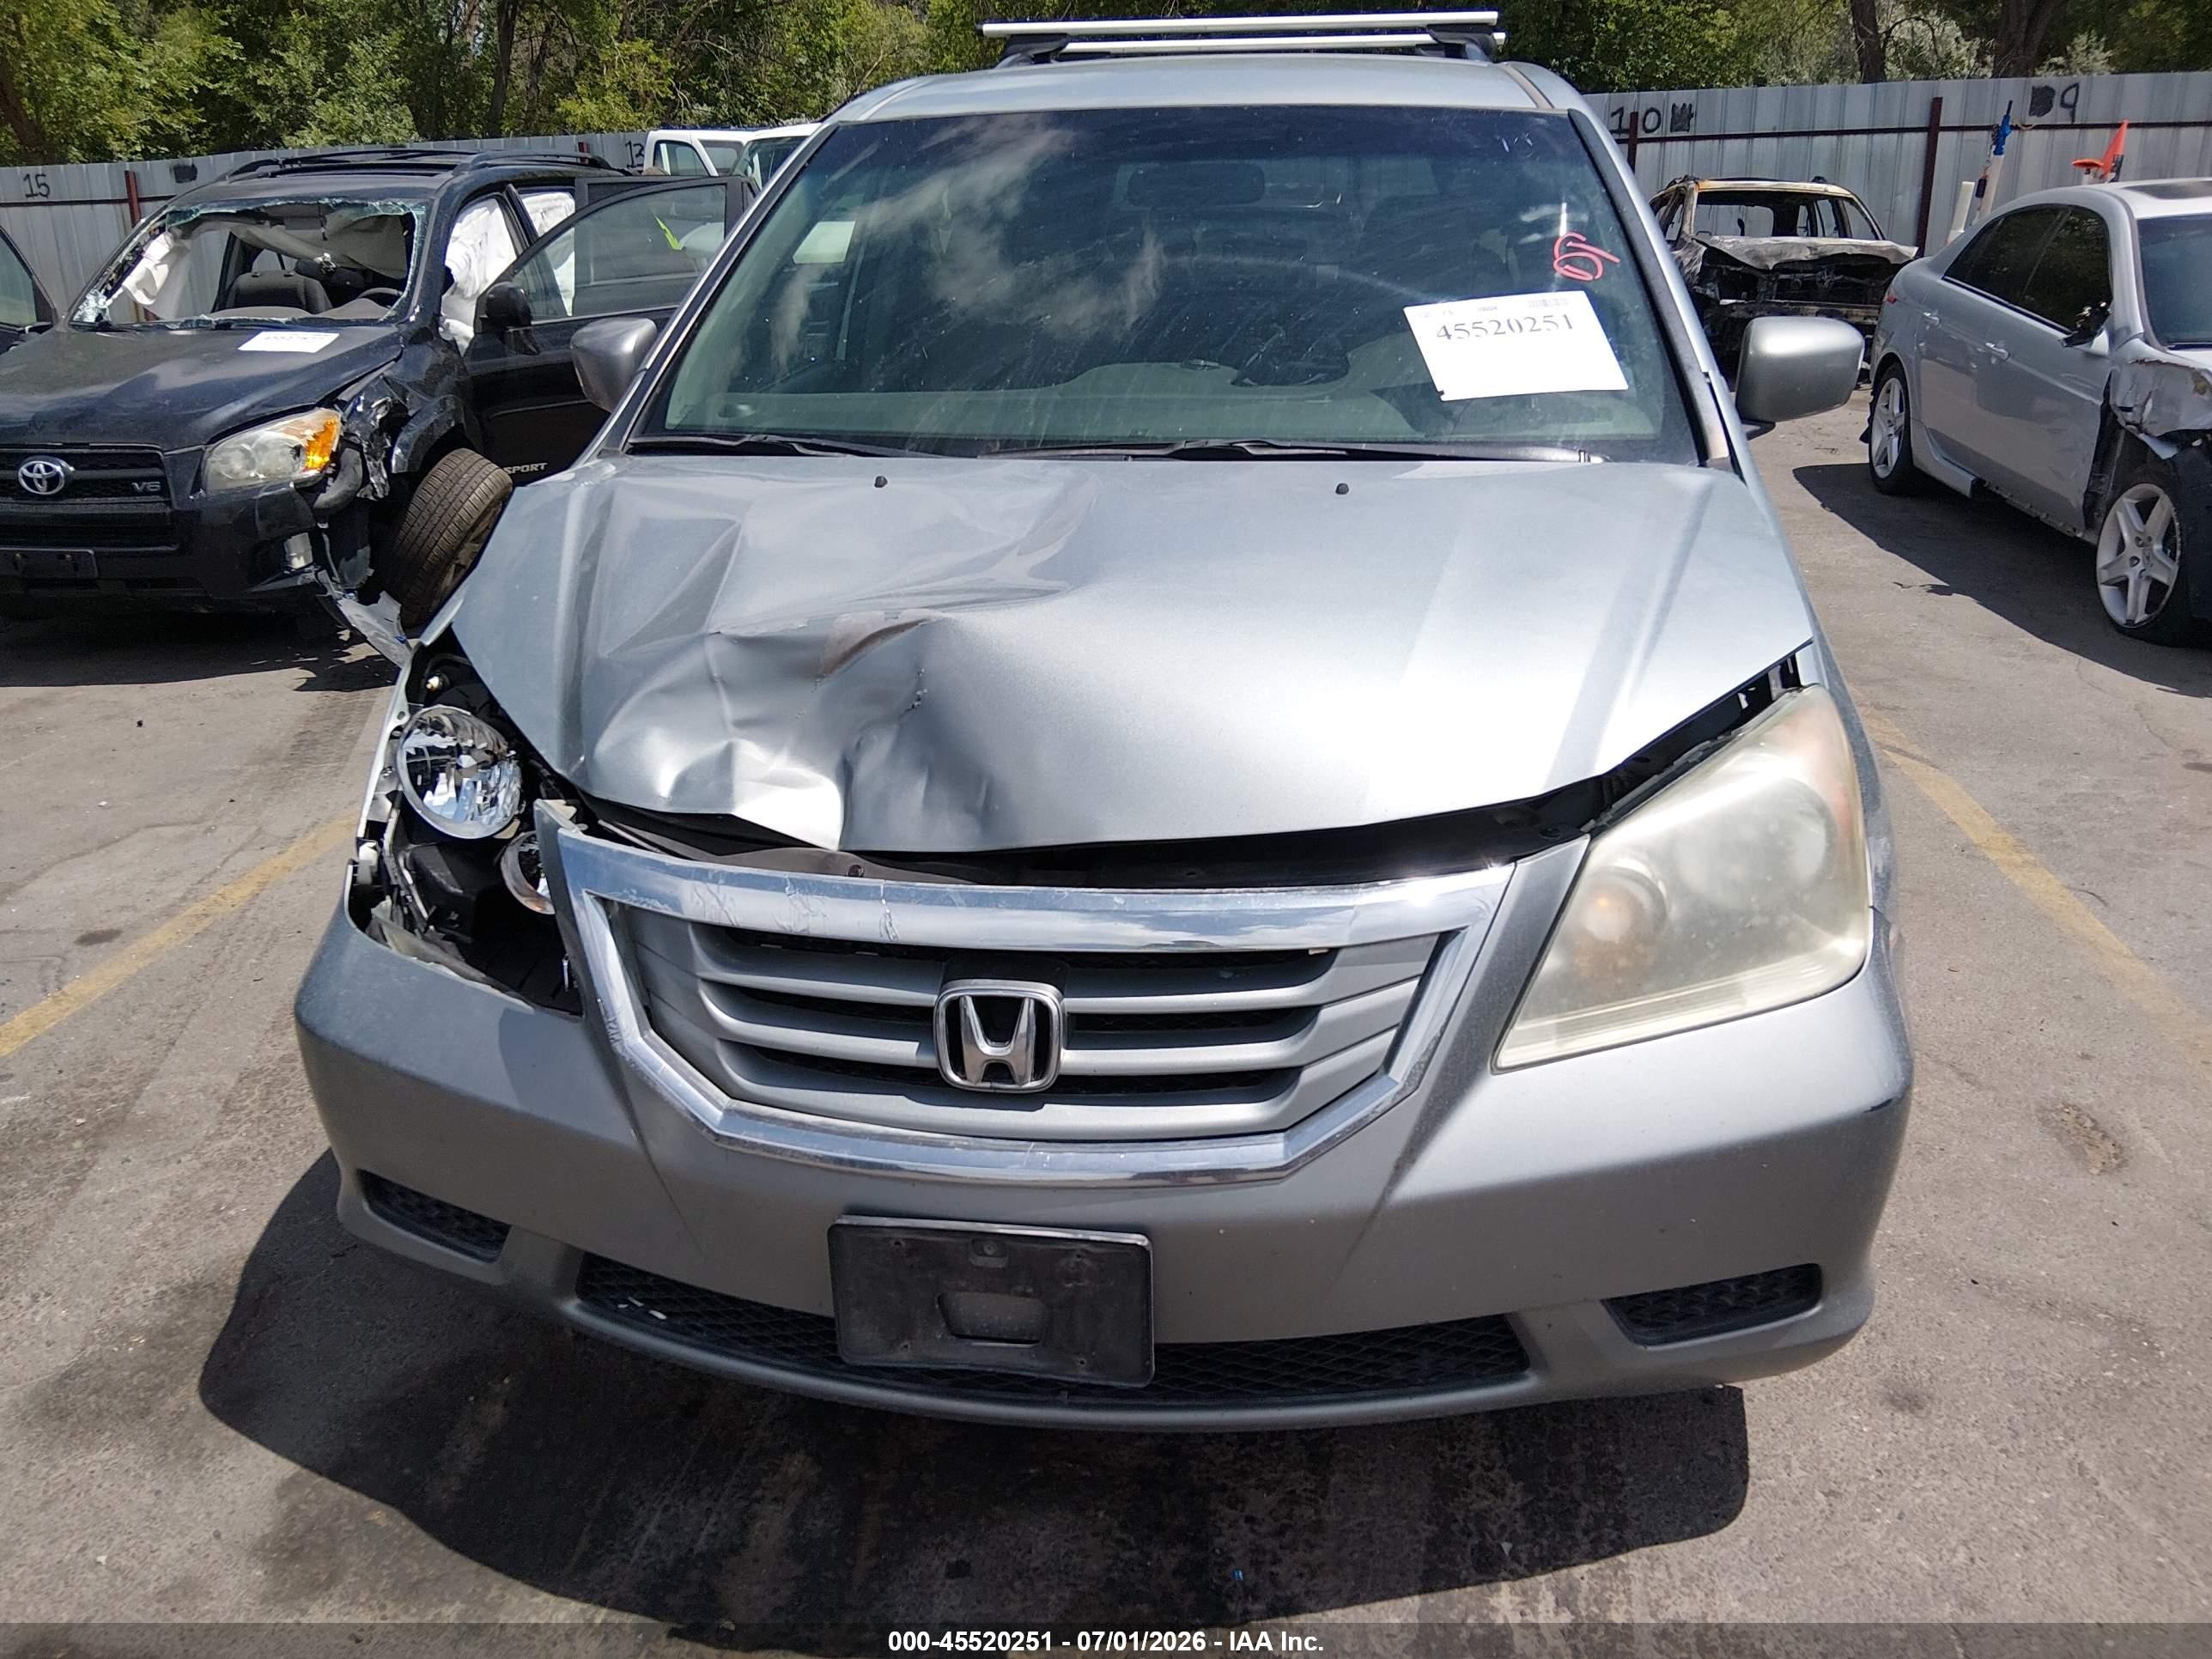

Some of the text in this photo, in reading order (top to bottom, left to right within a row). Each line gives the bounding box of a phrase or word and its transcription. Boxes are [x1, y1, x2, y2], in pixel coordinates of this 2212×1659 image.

[23, 173, 51, 198] 15
[1436, 313, 1573, 341] 45520251
[503, 462, 549, 475] SPORT
[131, 481, 161, 492] V6
